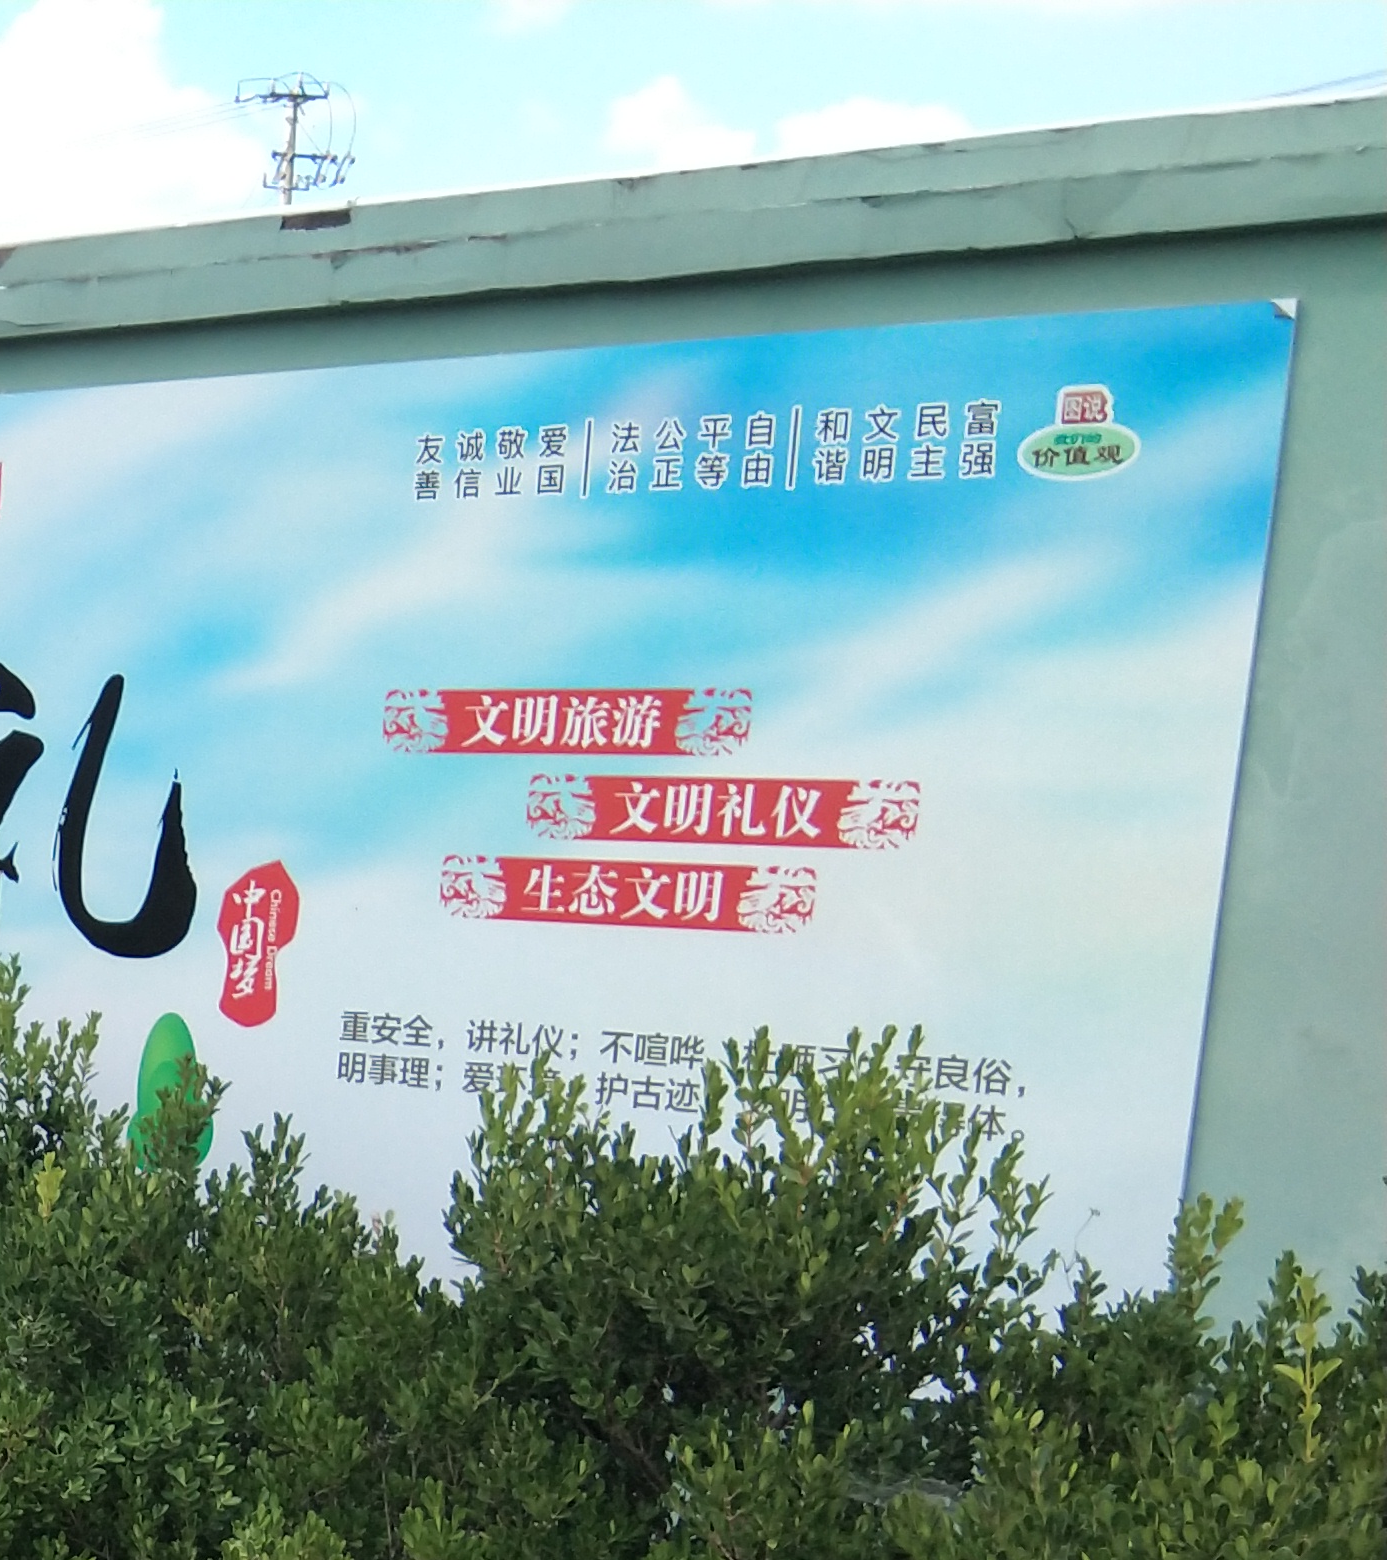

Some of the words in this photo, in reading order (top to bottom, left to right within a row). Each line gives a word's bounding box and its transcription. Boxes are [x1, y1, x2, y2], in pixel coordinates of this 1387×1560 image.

[1032, 445, 1124, 468] 价值观
[461, 694, 662, 749] 文明旅游
[610, 780, 822, 838] 文明礼仪
[267, 889, 282, 942] Chinese
[522, 864, 725, 922] 生态文明
[264, 945, 278, 991] Dream
